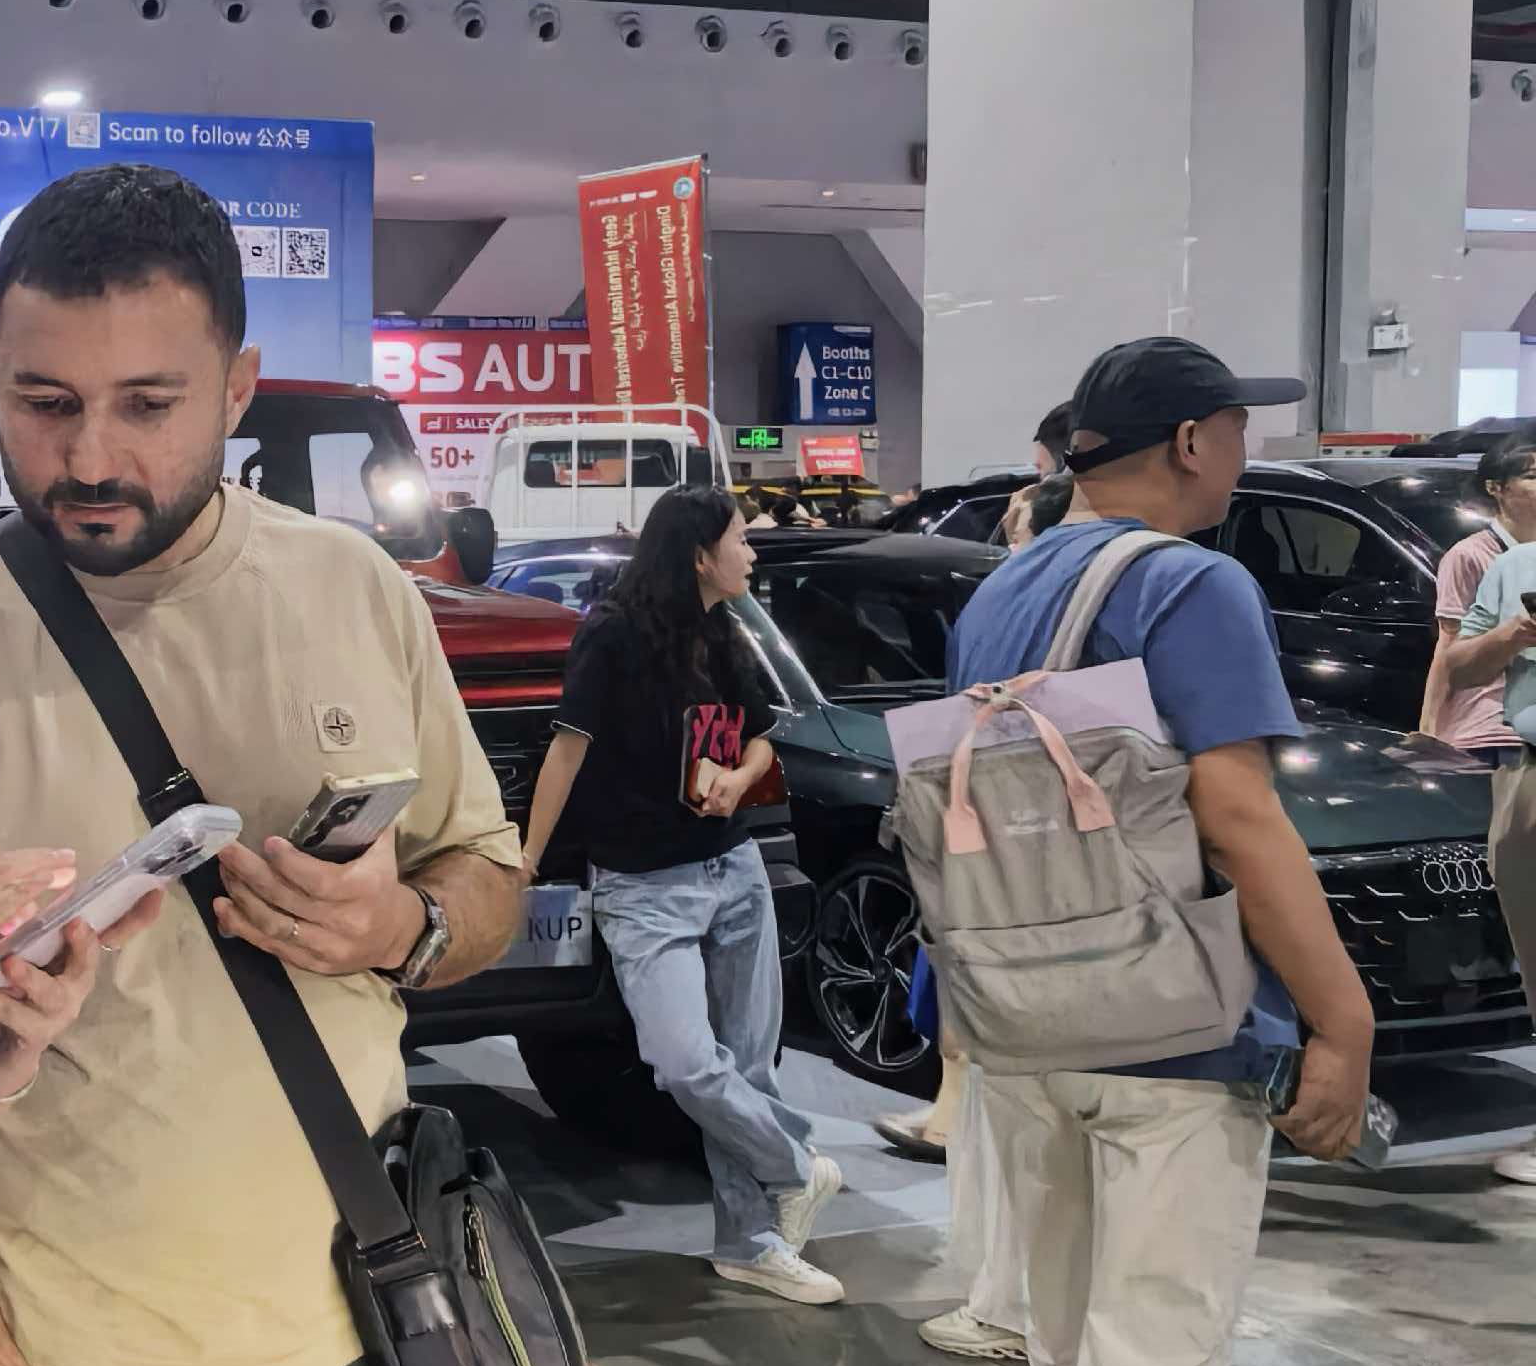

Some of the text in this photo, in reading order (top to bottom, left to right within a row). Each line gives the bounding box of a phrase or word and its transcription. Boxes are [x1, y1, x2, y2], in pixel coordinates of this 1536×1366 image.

[109, 122, 311, 149] Scan to follow 公众号
[220, 200, 302, 219] R CODE
[474, 343, 591, 393] AUT
[824, 386, 871, 400] Zone C
[430, 447, 475, 469] 50+
[528, 916, 582, 941] KUP
